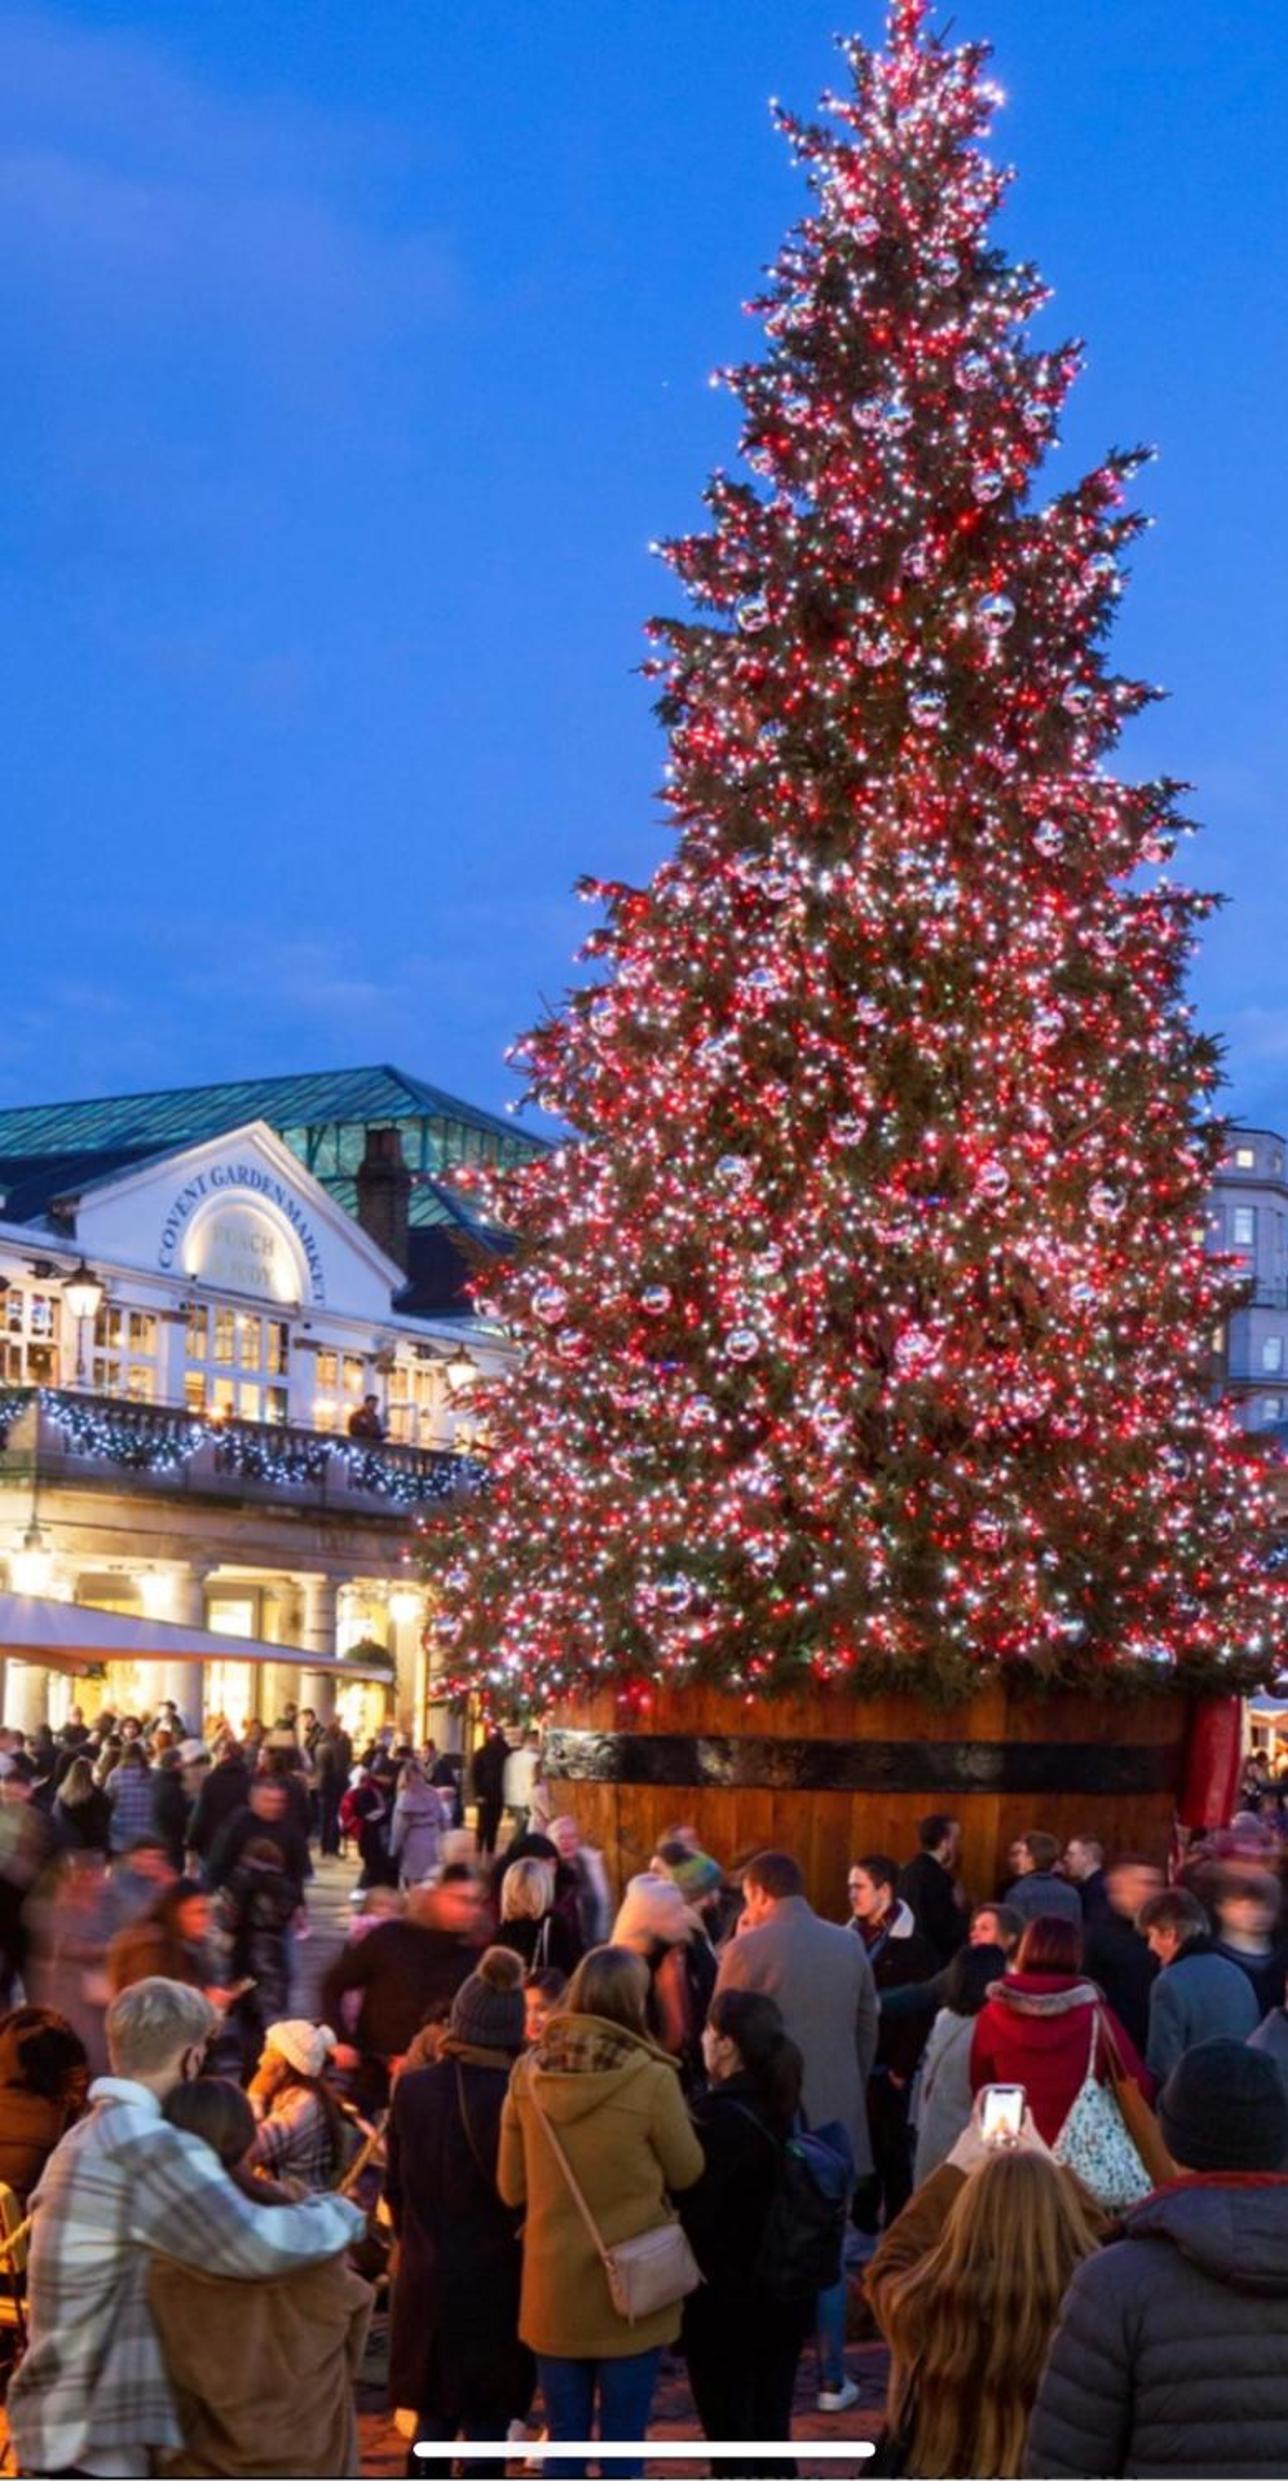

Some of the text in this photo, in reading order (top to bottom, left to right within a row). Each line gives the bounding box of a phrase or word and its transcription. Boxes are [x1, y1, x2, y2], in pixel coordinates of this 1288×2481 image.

[158, 1165, 325, 1307] COVENT GARDEN MARKET
